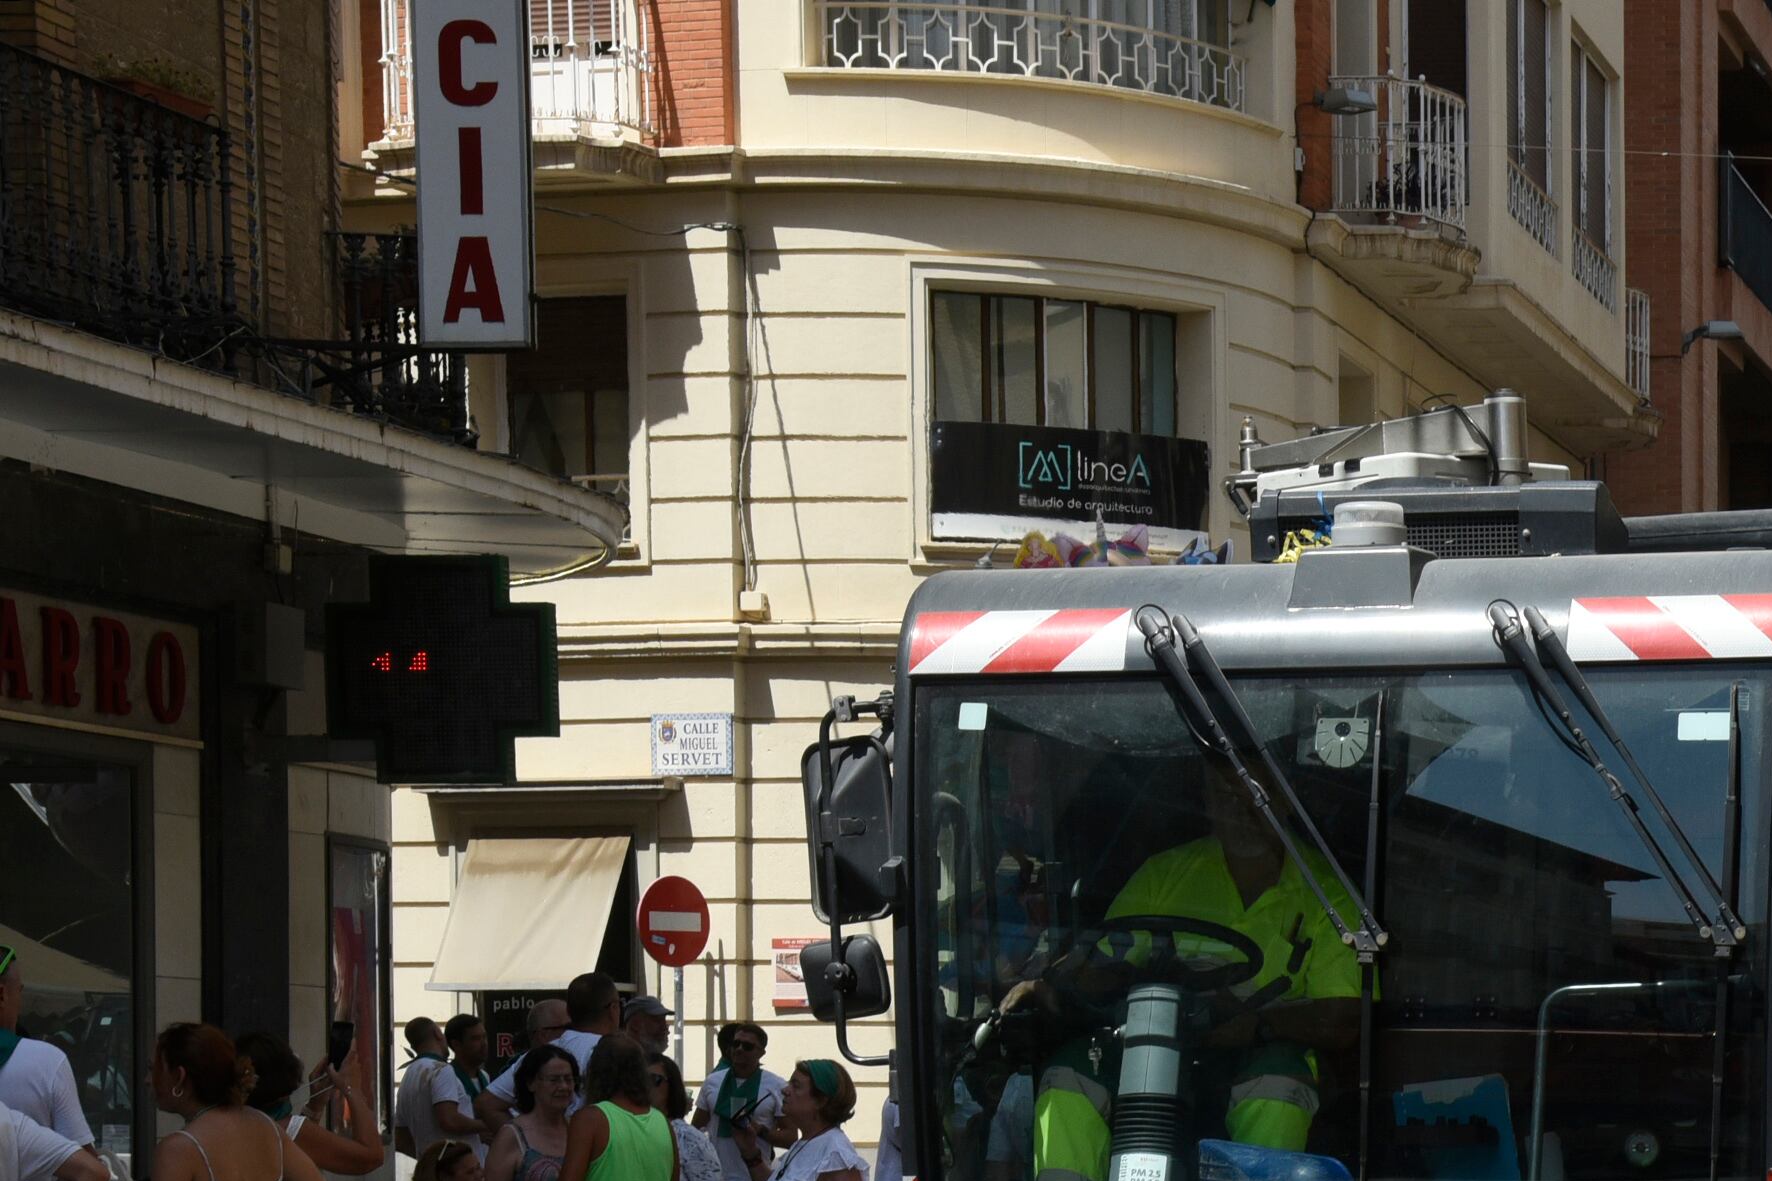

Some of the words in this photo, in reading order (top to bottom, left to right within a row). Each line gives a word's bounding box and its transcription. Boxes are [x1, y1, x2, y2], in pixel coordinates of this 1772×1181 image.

[438, 19, 505, 323] CIA
[1018, 493, 1064, 509] Estudio
[1067, 498, 1082, 509] de
[1084, 499, 1153, 515] arquitectura
[683, 723, 719, 735] CALLE
[680, 737, 718, 750] MIGUEL
[662, 752, 722, 766] SERVET
[493, 996, 535, 1013] pablo
[1130, 1168, 1147, 1177] PM
